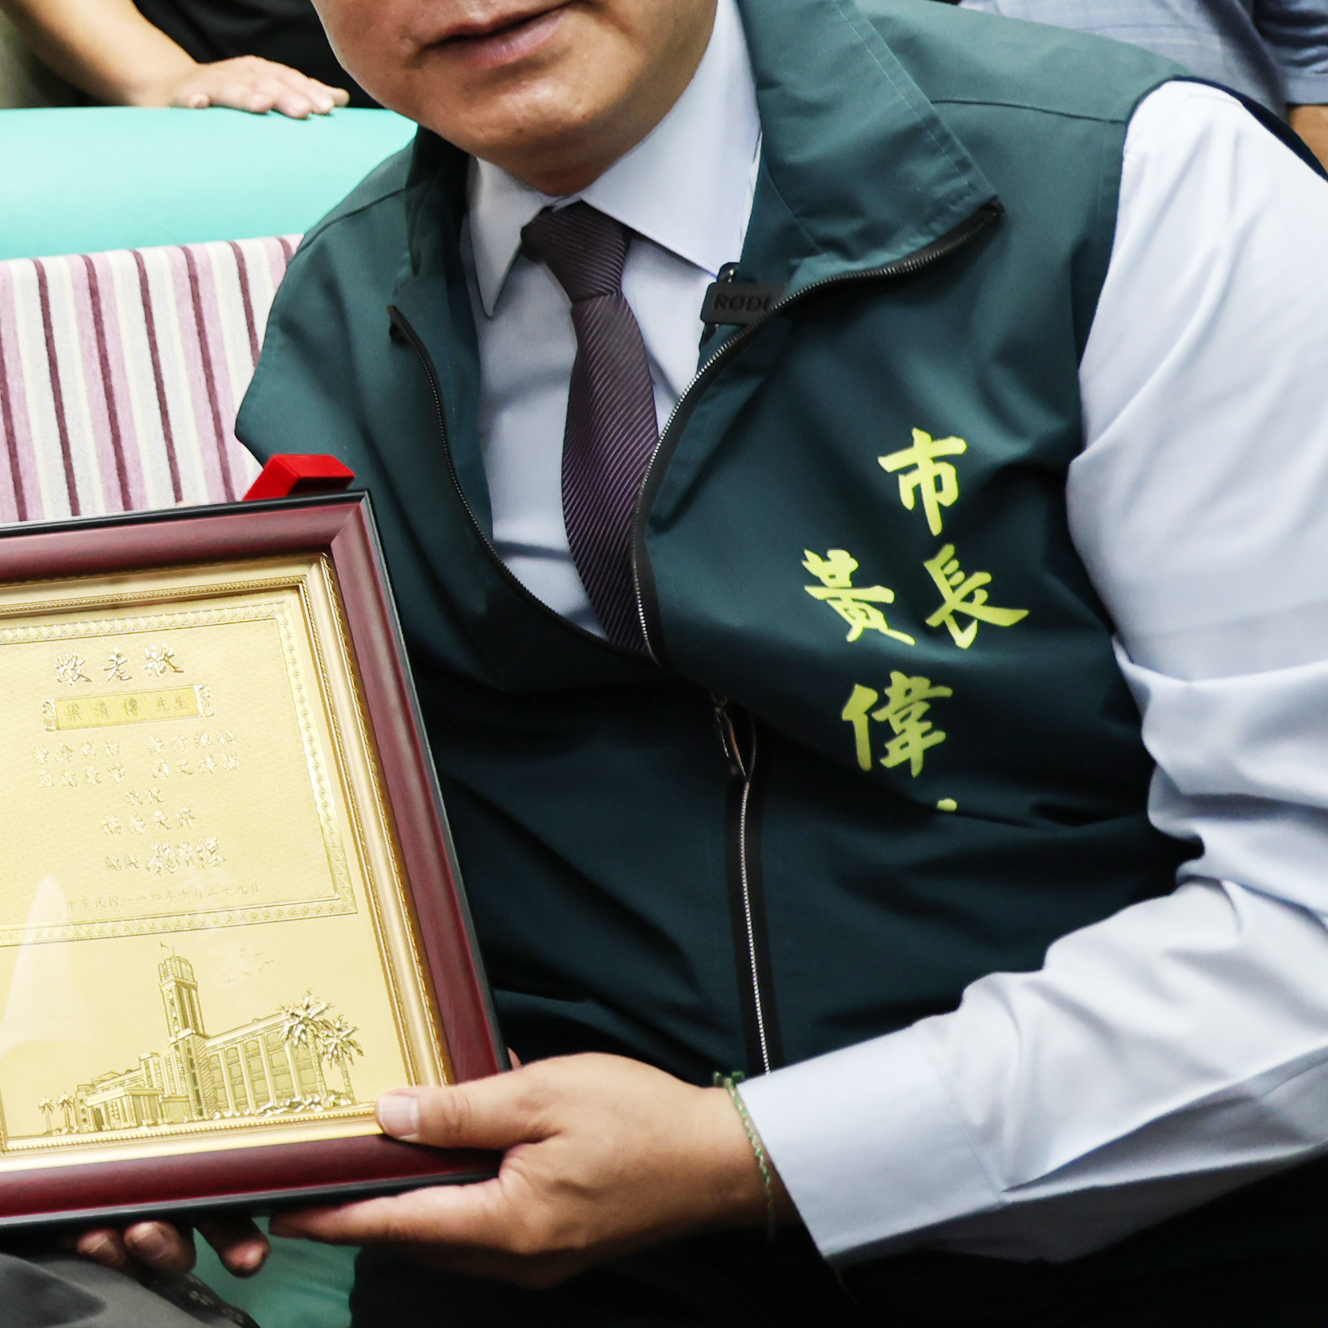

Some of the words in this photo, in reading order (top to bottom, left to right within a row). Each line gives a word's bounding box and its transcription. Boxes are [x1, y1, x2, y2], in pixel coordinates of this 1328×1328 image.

[878, 428, 1029, 649] 市長
[53, 642, 184, 686] 敬老狀
